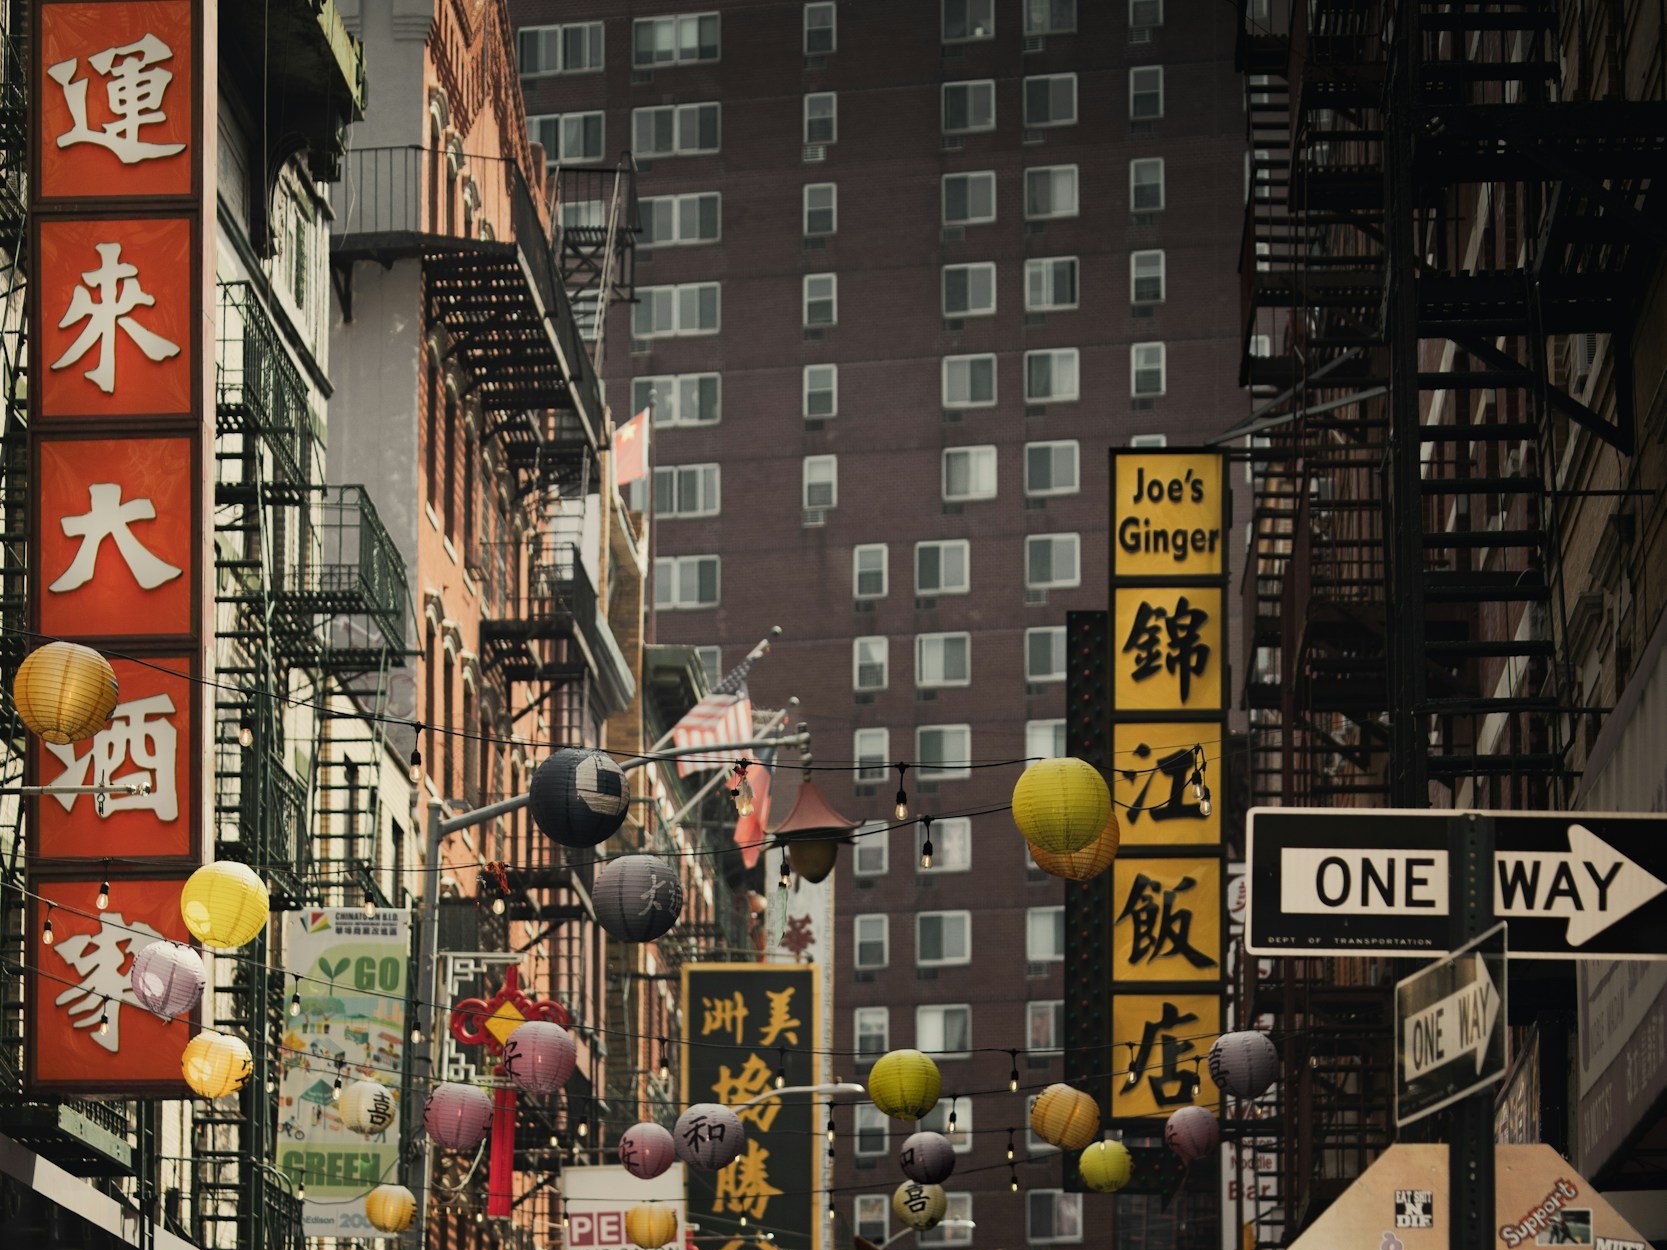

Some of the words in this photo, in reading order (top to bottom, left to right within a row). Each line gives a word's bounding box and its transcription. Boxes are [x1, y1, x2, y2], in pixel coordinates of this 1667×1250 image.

[1133, 467, 1204, 505] Joe's
[1118, 516, 1219, 561] Ginger
[1115, 595, 1218, 1108] 錦江飯店
[1315, 856, 1436, 908] ONE
[1497, 859, 1623, 912] WAY
[1266, 936, 1296, 945] DEPT
[1307, 936, 1321, 945] OF
[1334, 936, 1433, 946] TRANSPORTATION
[354, 956, 400, 992] GO
[1412, 1006, 1445, 1072] ONE
[1458, 980, 1491, 1046] WAY
[367, 1091, 392, 1127] 喜
[683, 1115, 727, 1154] 和
[282, 1151, 381, 1187] GREEN
[303, 1215, 335, 1224] Edison
[570, 1214, 622, 1244] PE
[1500, 1180, 1578, 1247] Support
